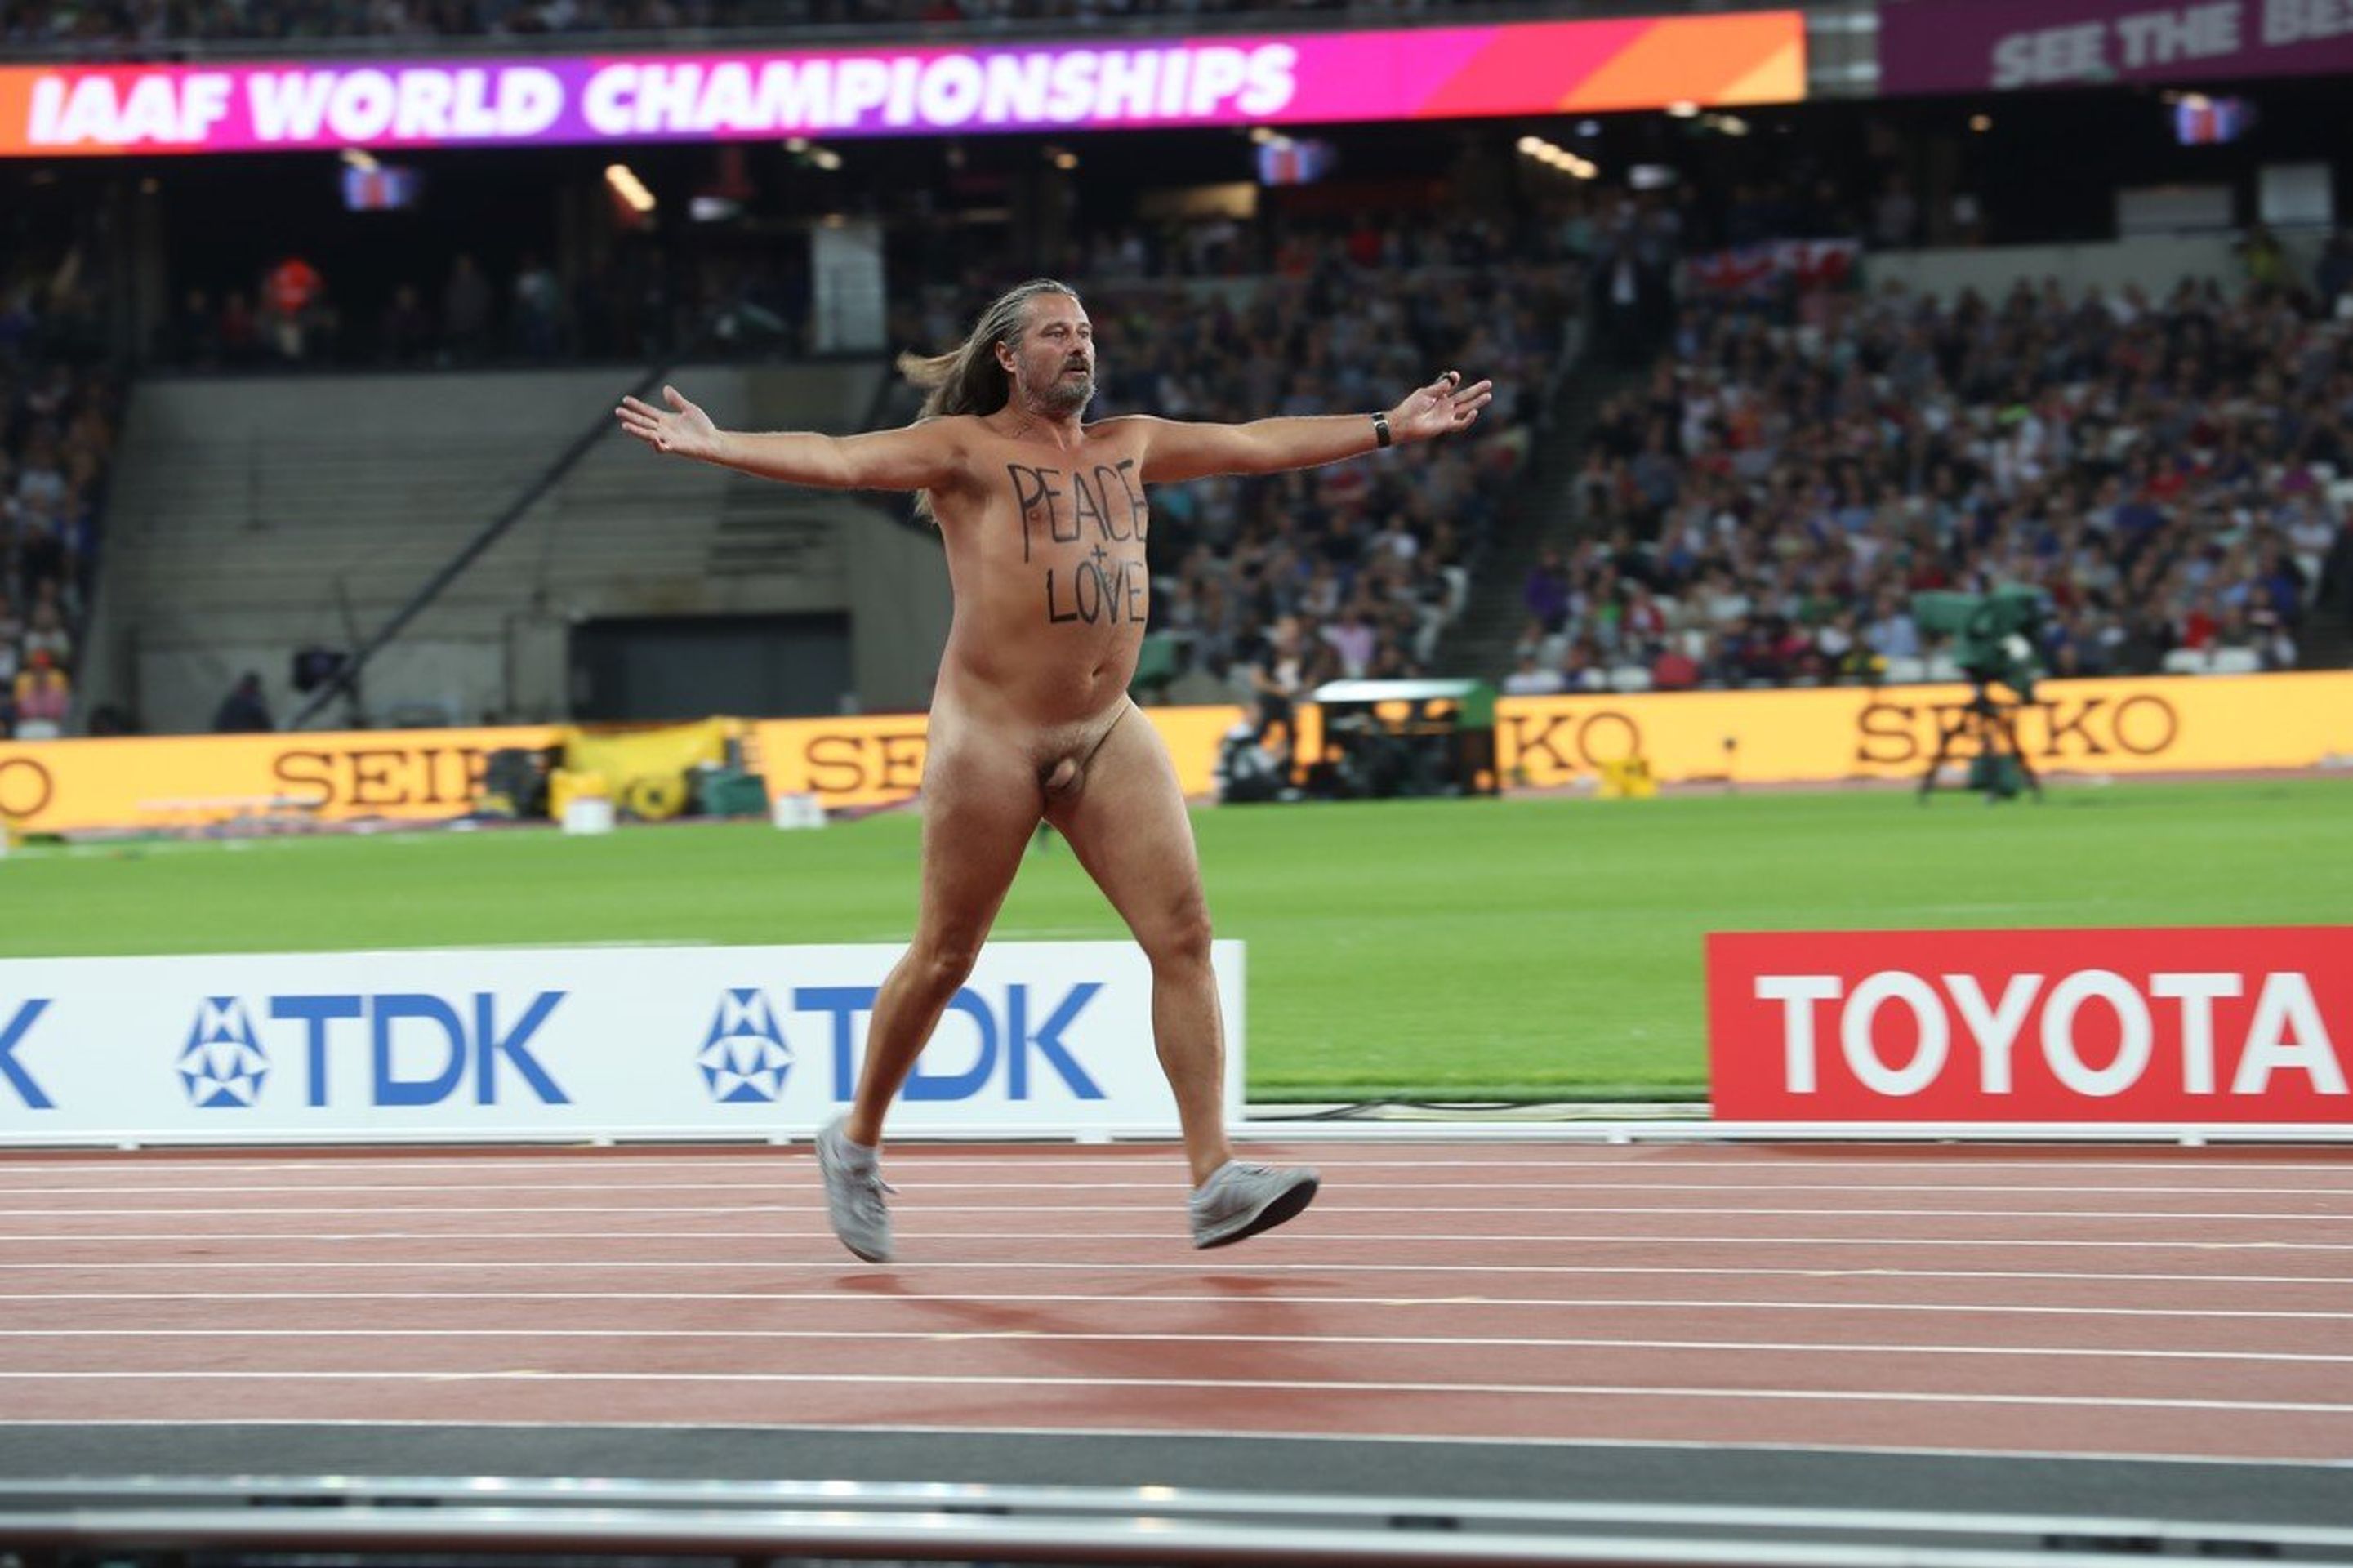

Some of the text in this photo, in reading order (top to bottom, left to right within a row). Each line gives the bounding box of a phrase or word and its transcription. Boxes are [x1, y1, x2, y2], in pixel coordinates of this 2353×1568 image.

[28, 43, 1298, 145] IAAF WORLD CHAMPIONSHIPS
[1990, 22, 2107, 90] SEE
[2117, 2, 2241, 69] THE
[1007, 459, 1149, 563] PEACE
[1046, 559, 1145, 624] LOVE
[267, 990, 574, 1107] TDK
[791, 982, 1108, 1102] TDK
[1754, 969, 2350, 1097] TOYOTA
